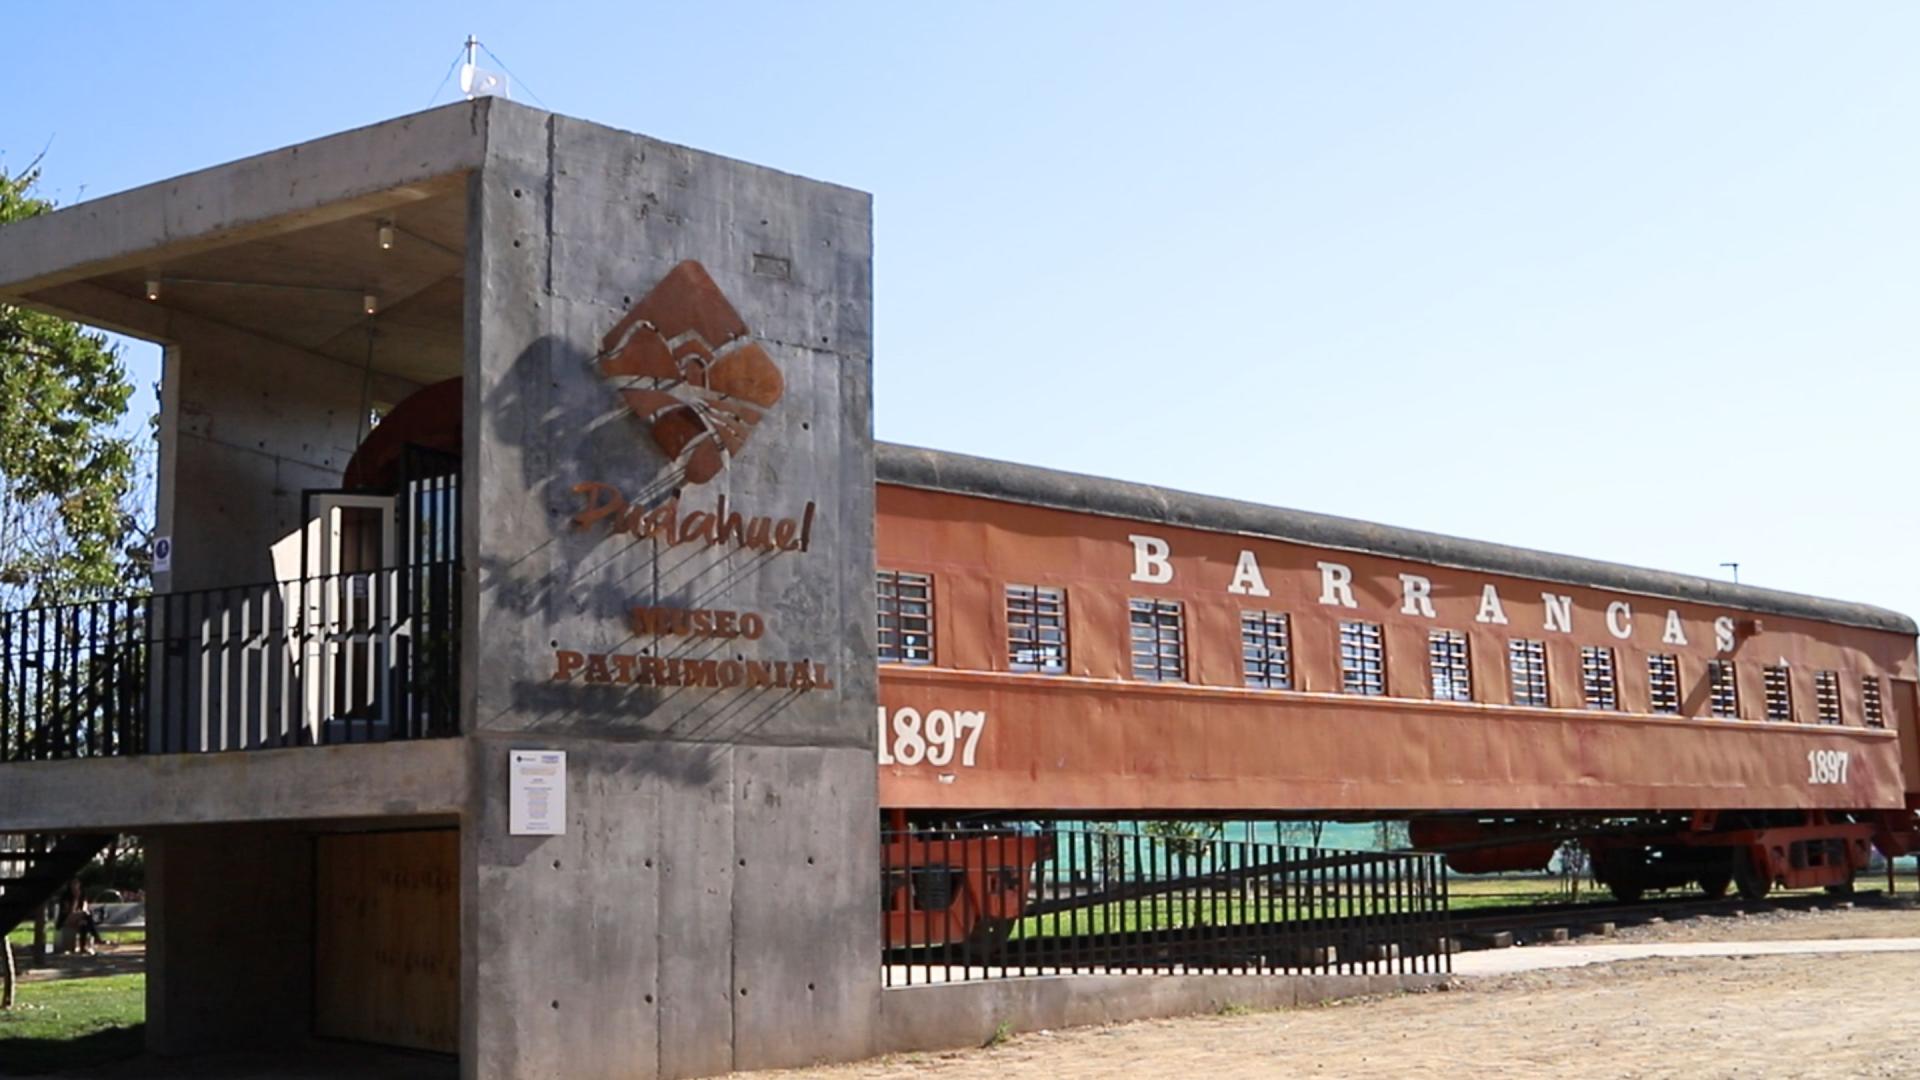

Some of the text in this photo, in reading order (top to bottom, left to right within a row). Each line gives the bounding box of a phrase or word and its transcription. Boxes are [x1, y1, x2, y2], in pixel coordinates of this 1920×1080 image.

[1128, 533, 1736, 653] BARRANCAS
[631, 607, 765, 640] MUSEO
[553, 650, 834, 690] PATRIMONIAL
[877, 706, 986, 767] 1897
[1807, 749, 1849, 785] 1897
